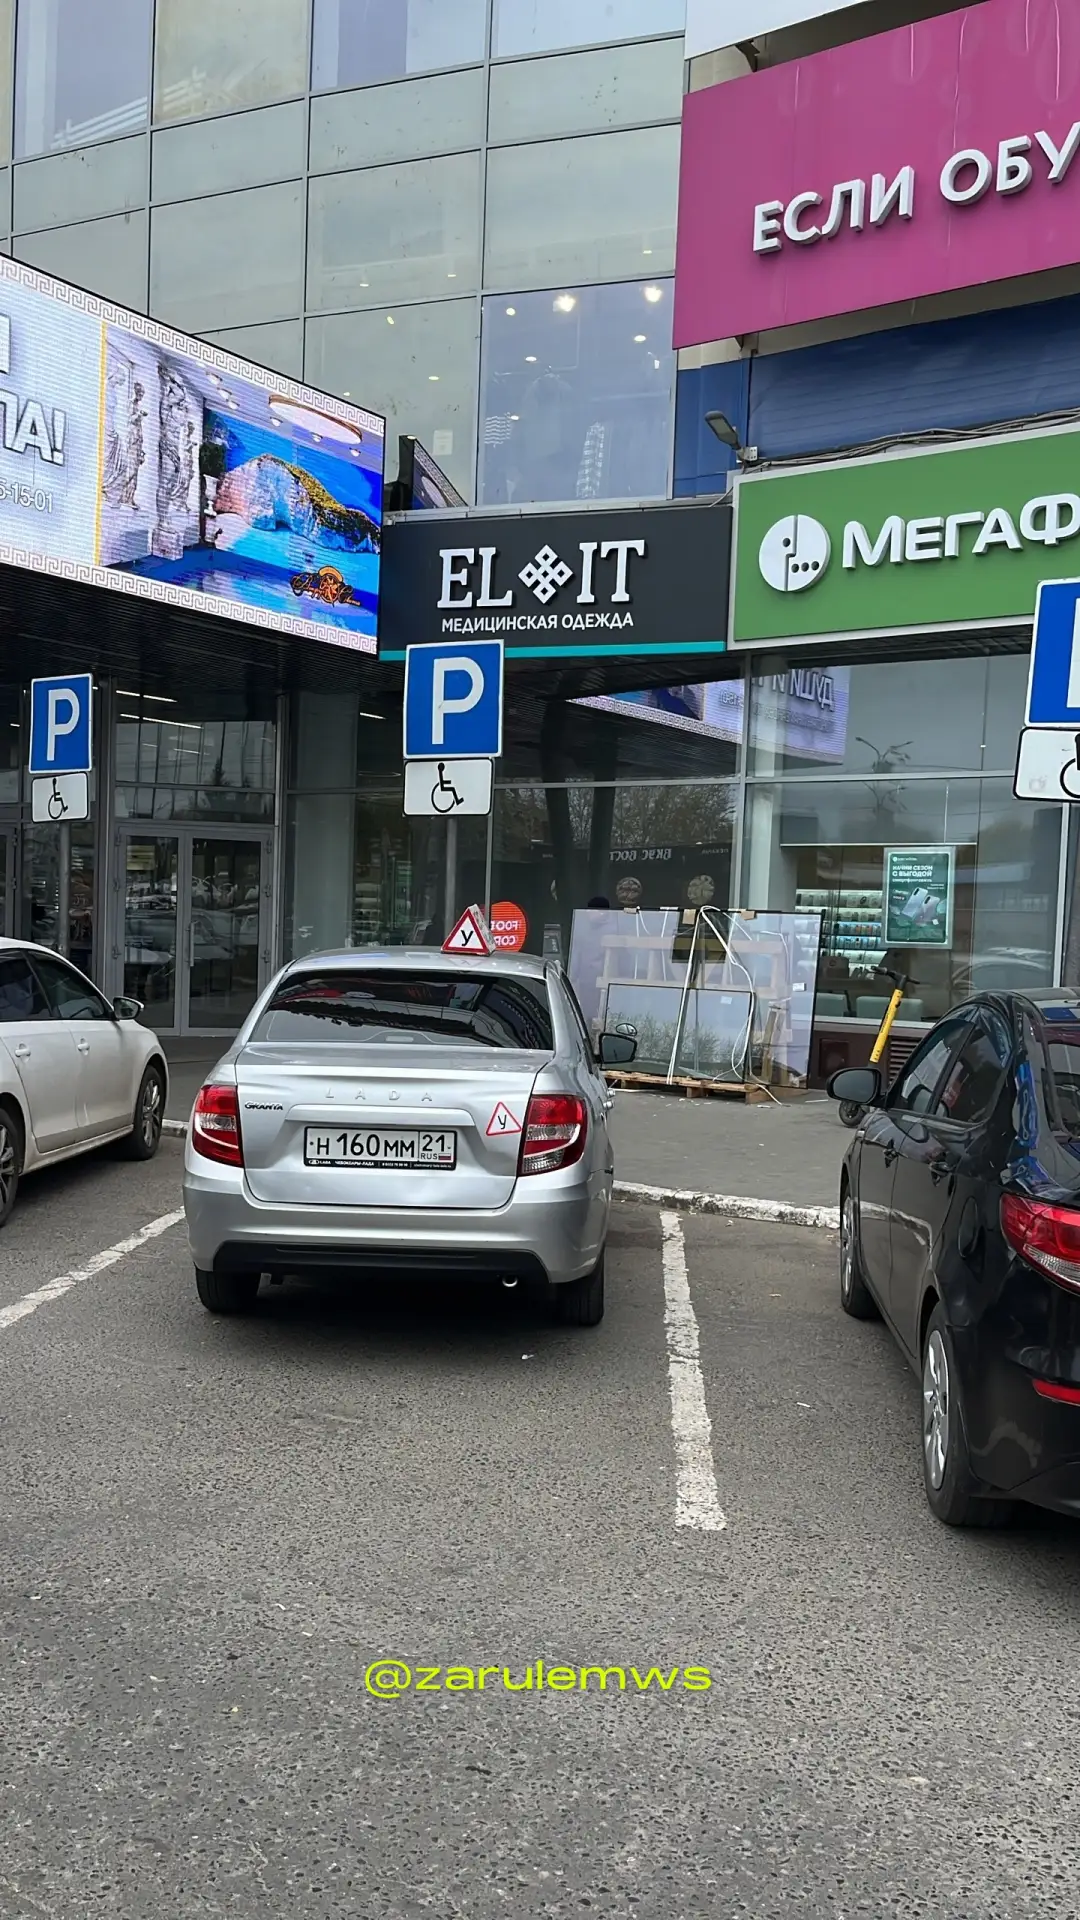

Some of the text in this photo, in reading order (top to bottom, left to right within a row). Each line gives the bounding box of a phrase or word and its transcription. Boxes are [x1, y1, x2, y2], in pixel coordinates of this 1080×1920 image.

[753, 165, 915, 254] ЕСЛИ
[437, 547, 513, 609] EL
[576, 539, 646, 604] IT
[441, 612, 634, 634] МЕДИЦИНСКАЯ ОДЕЖДА
[46, 688, 80, 761] P
[431, 656, 485, 745] P
[460, 930, 474, 946] У
[325, 1087, 433, 1102] LADA
